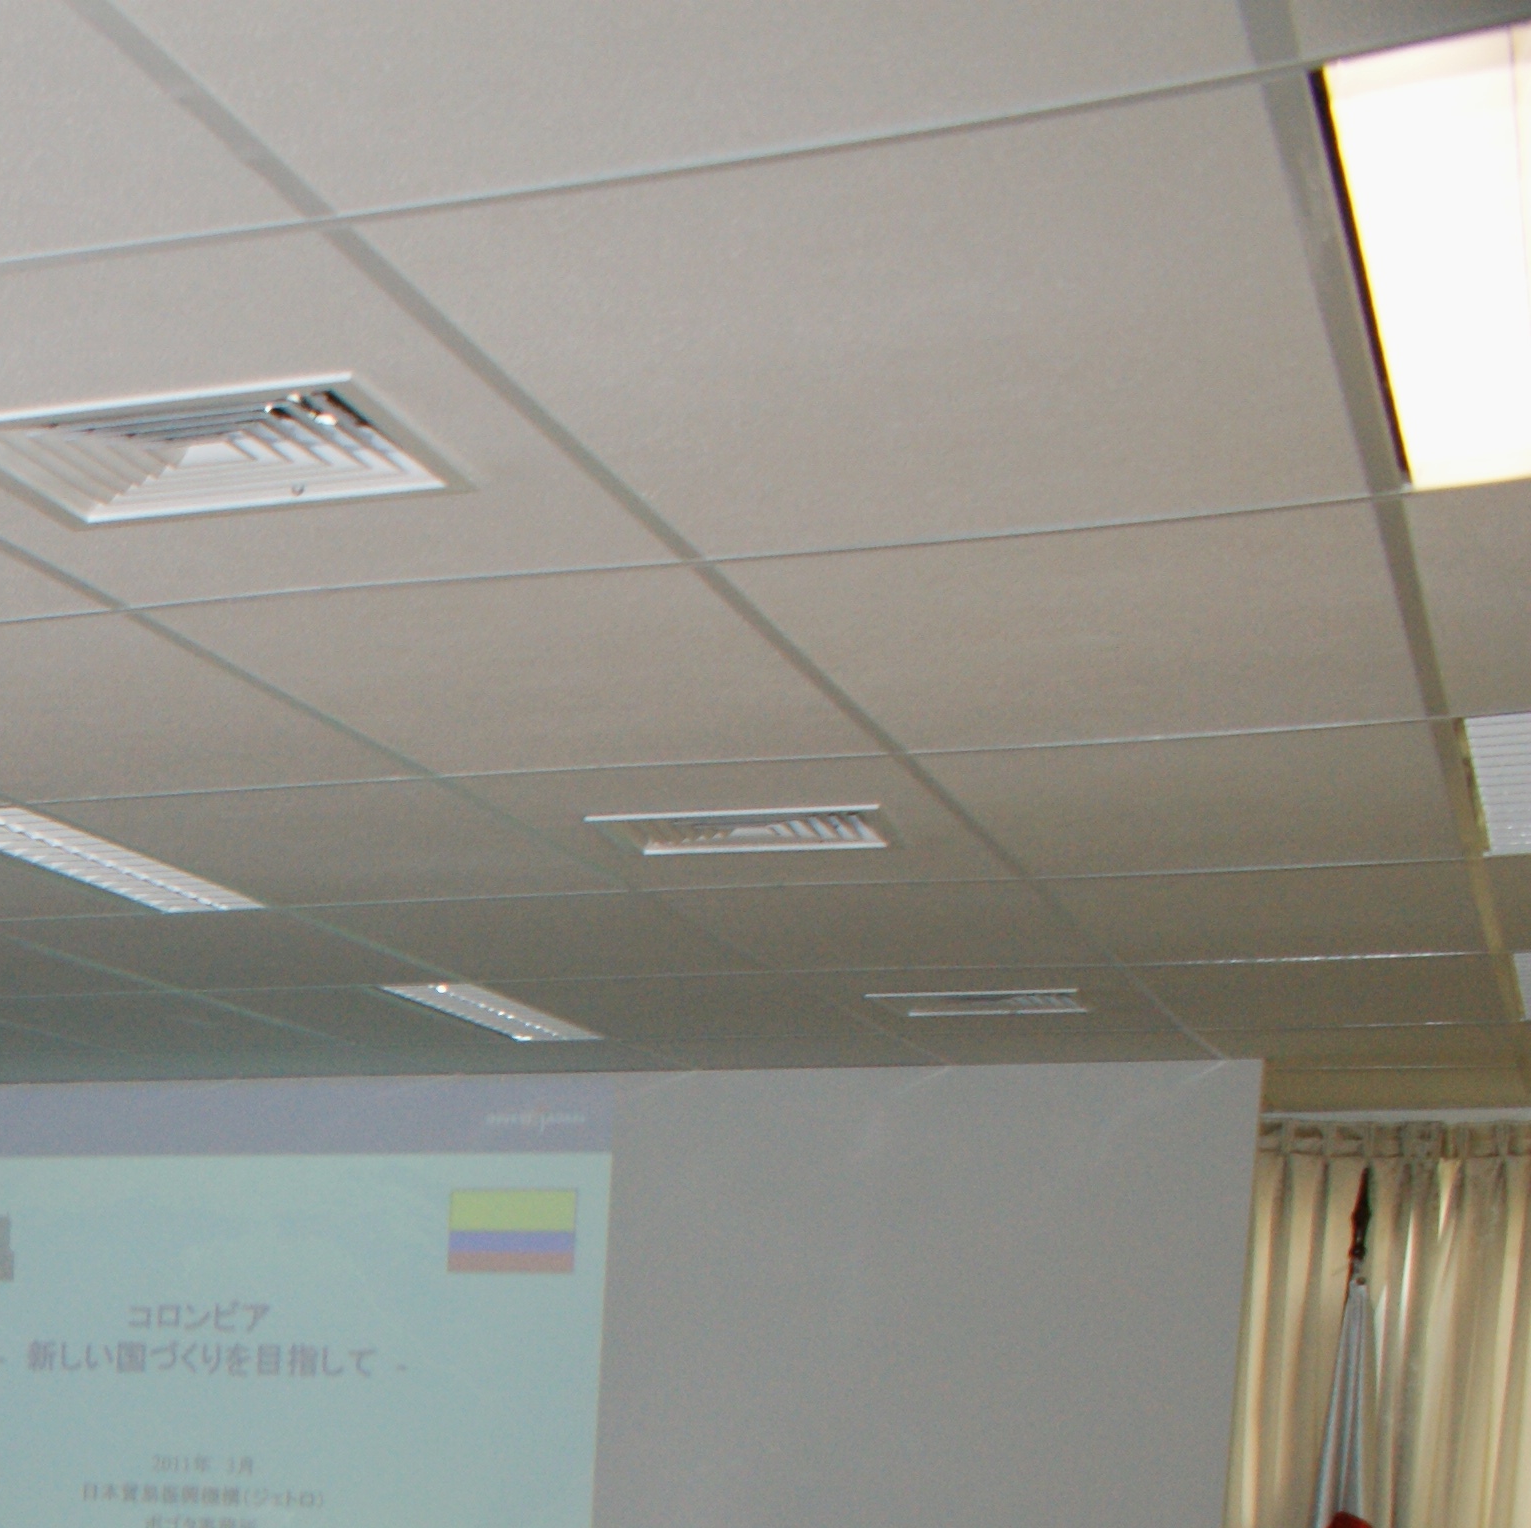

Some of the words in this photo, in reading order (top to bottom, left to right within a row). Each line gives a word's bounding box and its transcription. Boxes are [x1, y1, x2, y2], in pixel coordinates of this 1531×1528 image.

[127, 1302, 271, 1332] コロンビア
